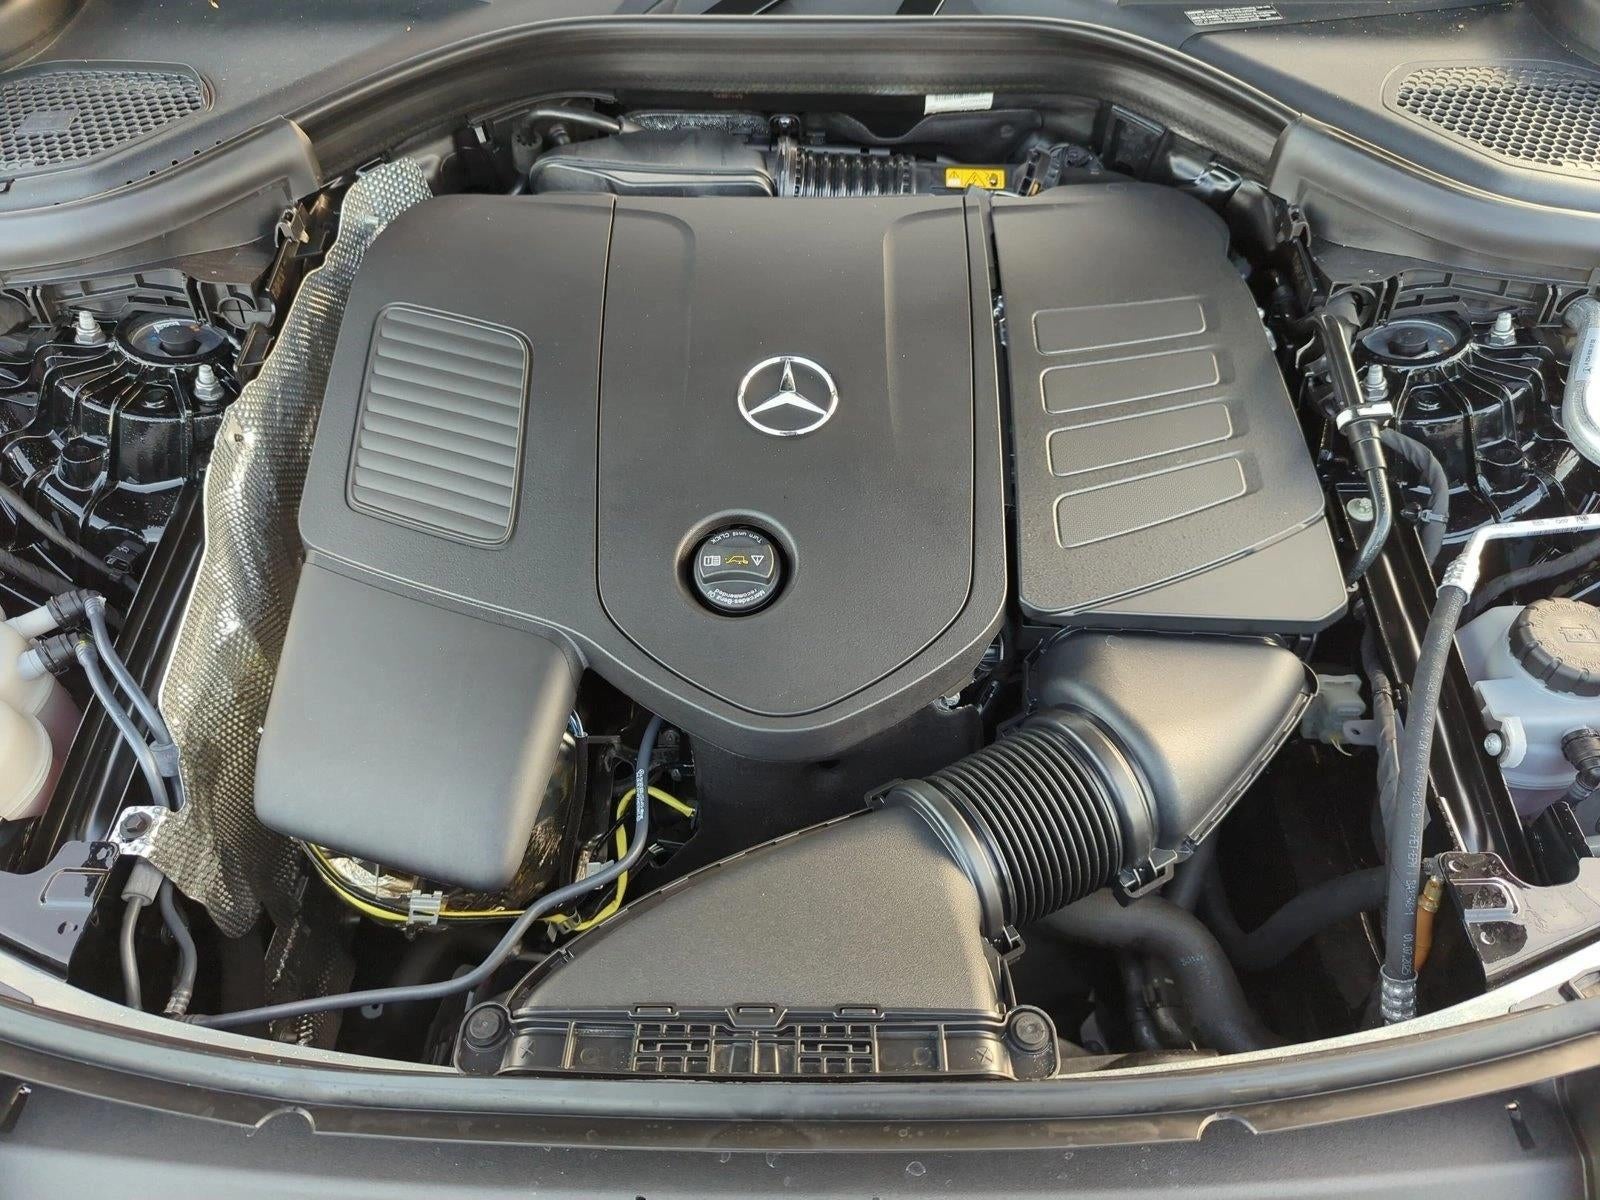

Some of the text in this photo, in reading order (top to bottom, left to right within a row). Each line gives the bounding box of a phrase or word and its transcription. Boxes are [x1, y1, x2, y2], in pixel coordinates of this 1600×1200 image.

[710, 532, 730, 544] CLICK
[749, 533, 763, 543] Turn
[714, 588, 758, 599] recommended
[716, 589, 766, 605] Mercedes-Benz
